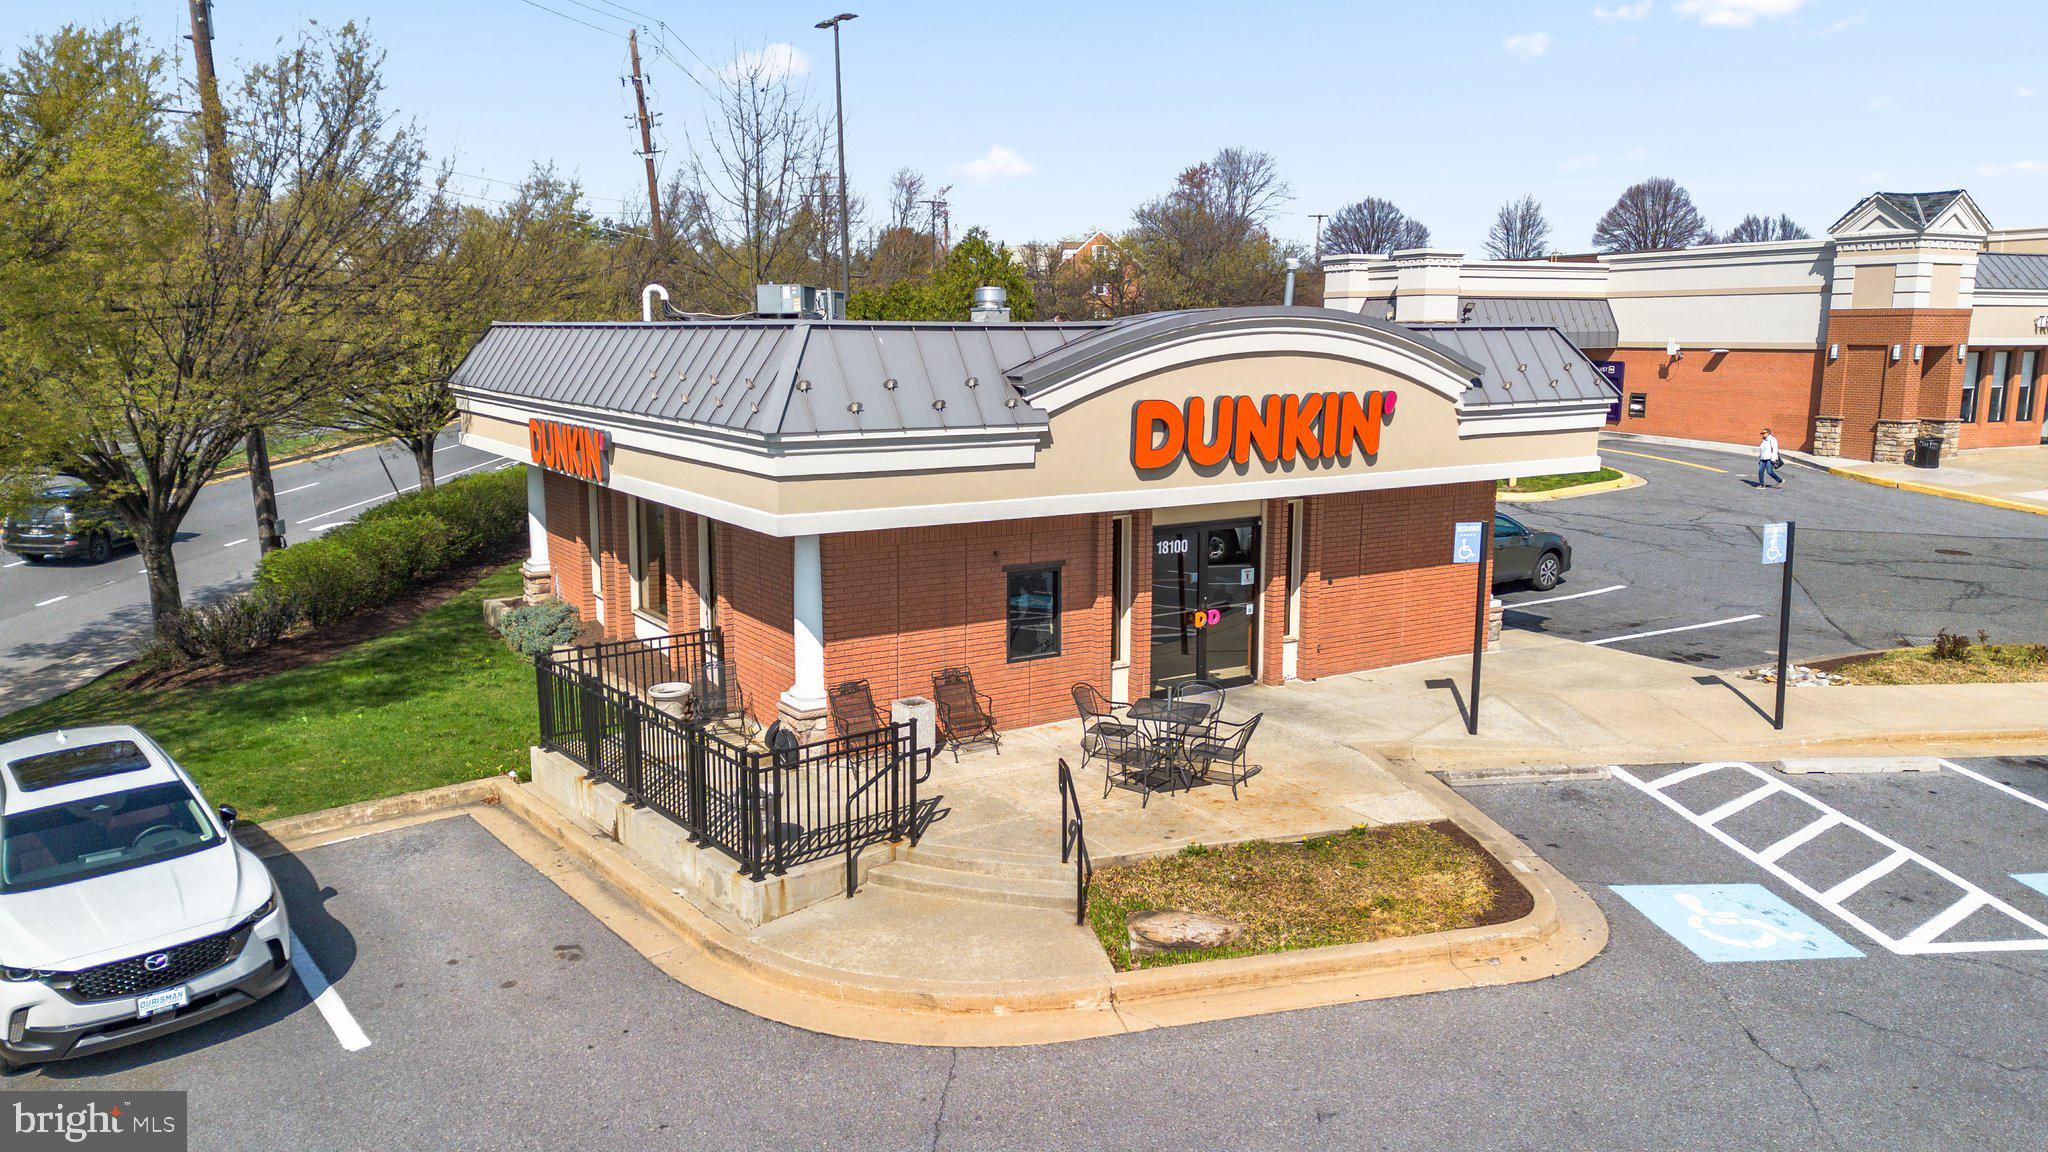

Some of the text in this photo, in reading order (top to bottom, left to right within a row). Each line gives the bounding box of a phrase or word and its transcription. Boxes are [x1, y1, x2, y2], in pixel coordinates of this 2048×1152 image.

[529, 417, 604, 482] DUNKIN'
[1132, 390, 1397, 469] DUNKIN'
[1156, 539, 1188, 555] 18100
